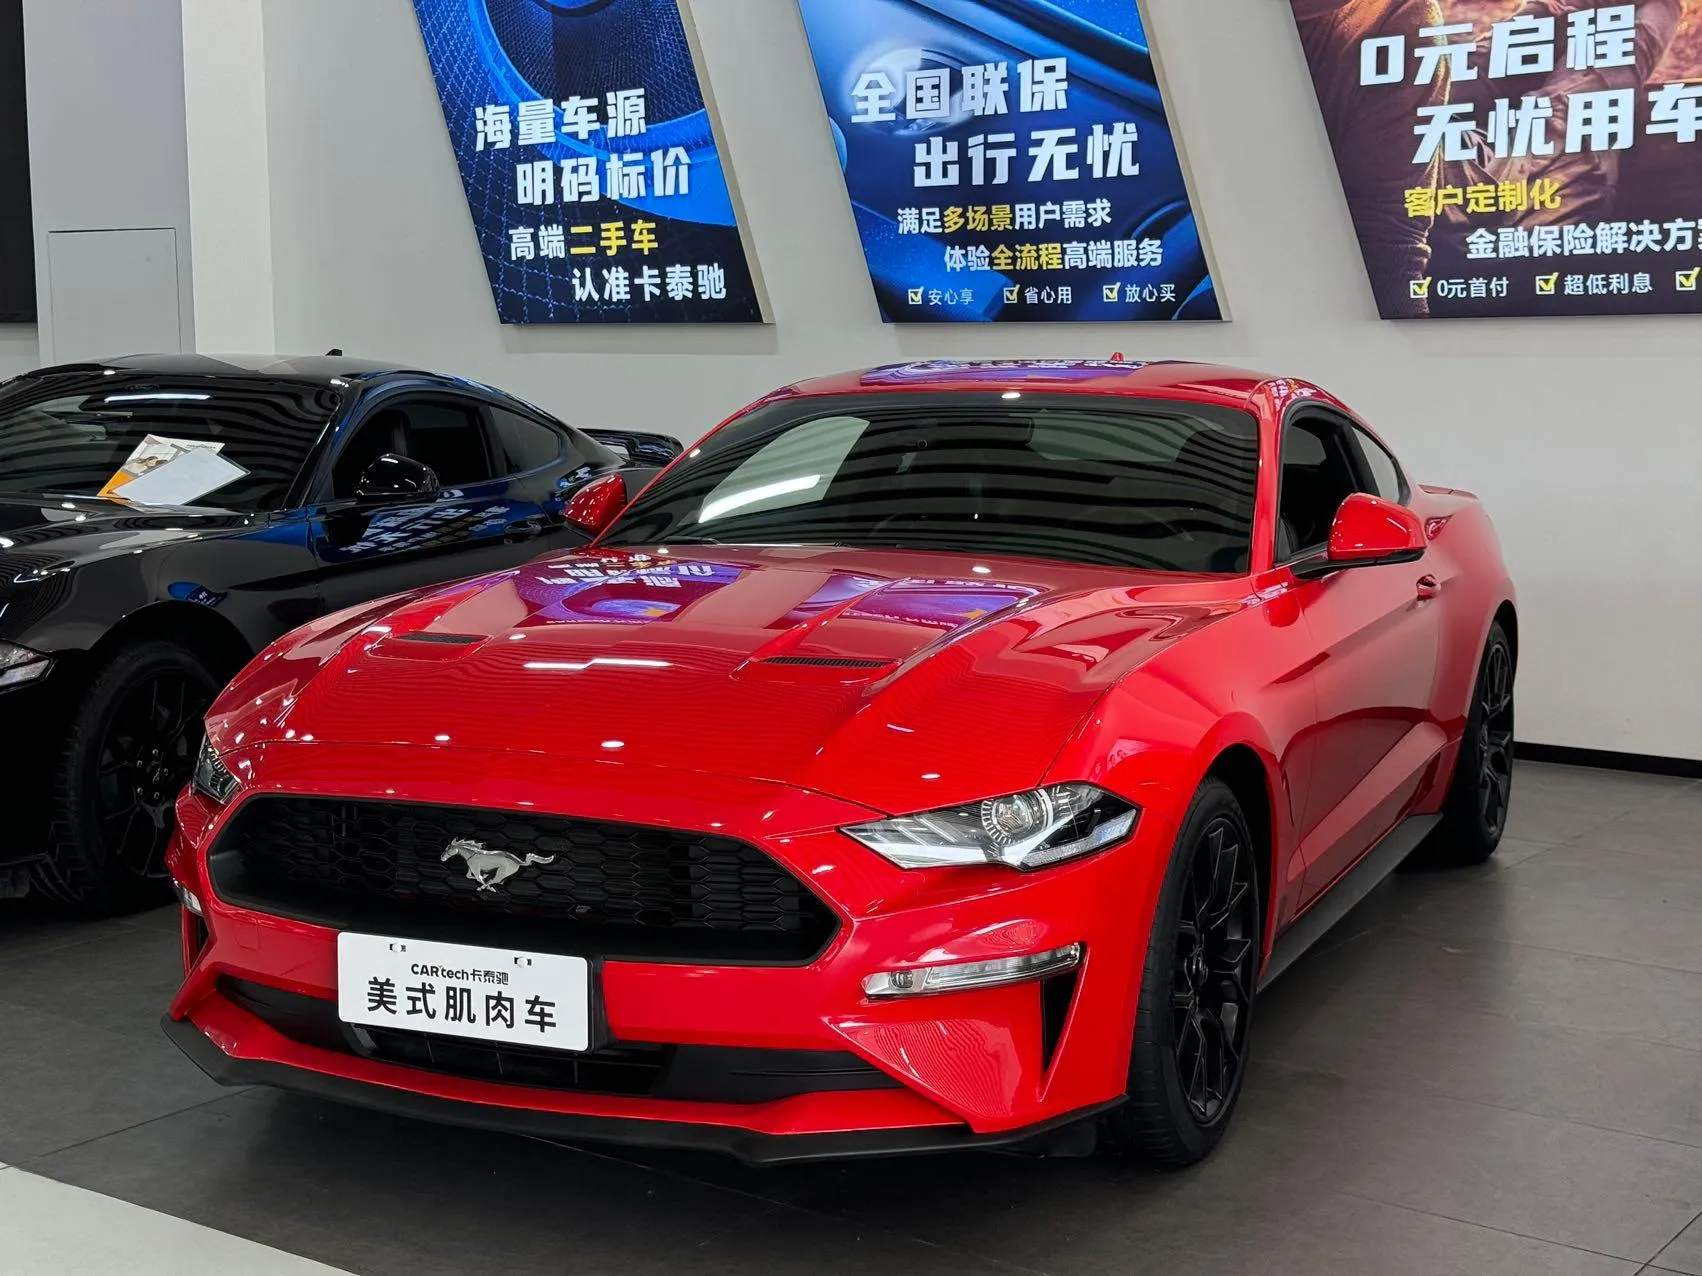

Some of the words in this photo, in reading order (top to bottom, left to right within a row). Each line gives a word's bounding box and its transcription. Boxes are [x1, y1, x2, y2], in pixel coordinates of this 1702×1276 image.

[1360, 4, 1636, 86] 0元启程
[851, 57, 1069, 123] 全国联保
[475, 88, 646, 151] 海量车源
[1411, 82, 1702, 164] 无忧用车
[913, 122, 1140, 187] 出行无忧
[516, 148, 692, 206] 明码标价
[897, 199, 1112, 234] 满足多场景用户需求
[1404, 178, 1562, 218] 客户定制化
[509, 220, 658, 261] 高端二手车
[945, 239, 1163, 273] 体验全流程高端服务
[1466, 218, 1702, 259] 金融保险解决方
[572, 263, 727, 302] 认准卡泰驰
[928, 288, 974, 305] 安心享
[1024, 287, 1073, 305] 省心用
[1125, 284, 1176, 303] 放心买
[1437, 276, 1509, 298] 0元首付
[1564, 272, 1653, 295] 超低利息
[367, 976, 556, 1033] 美式肌肉车
